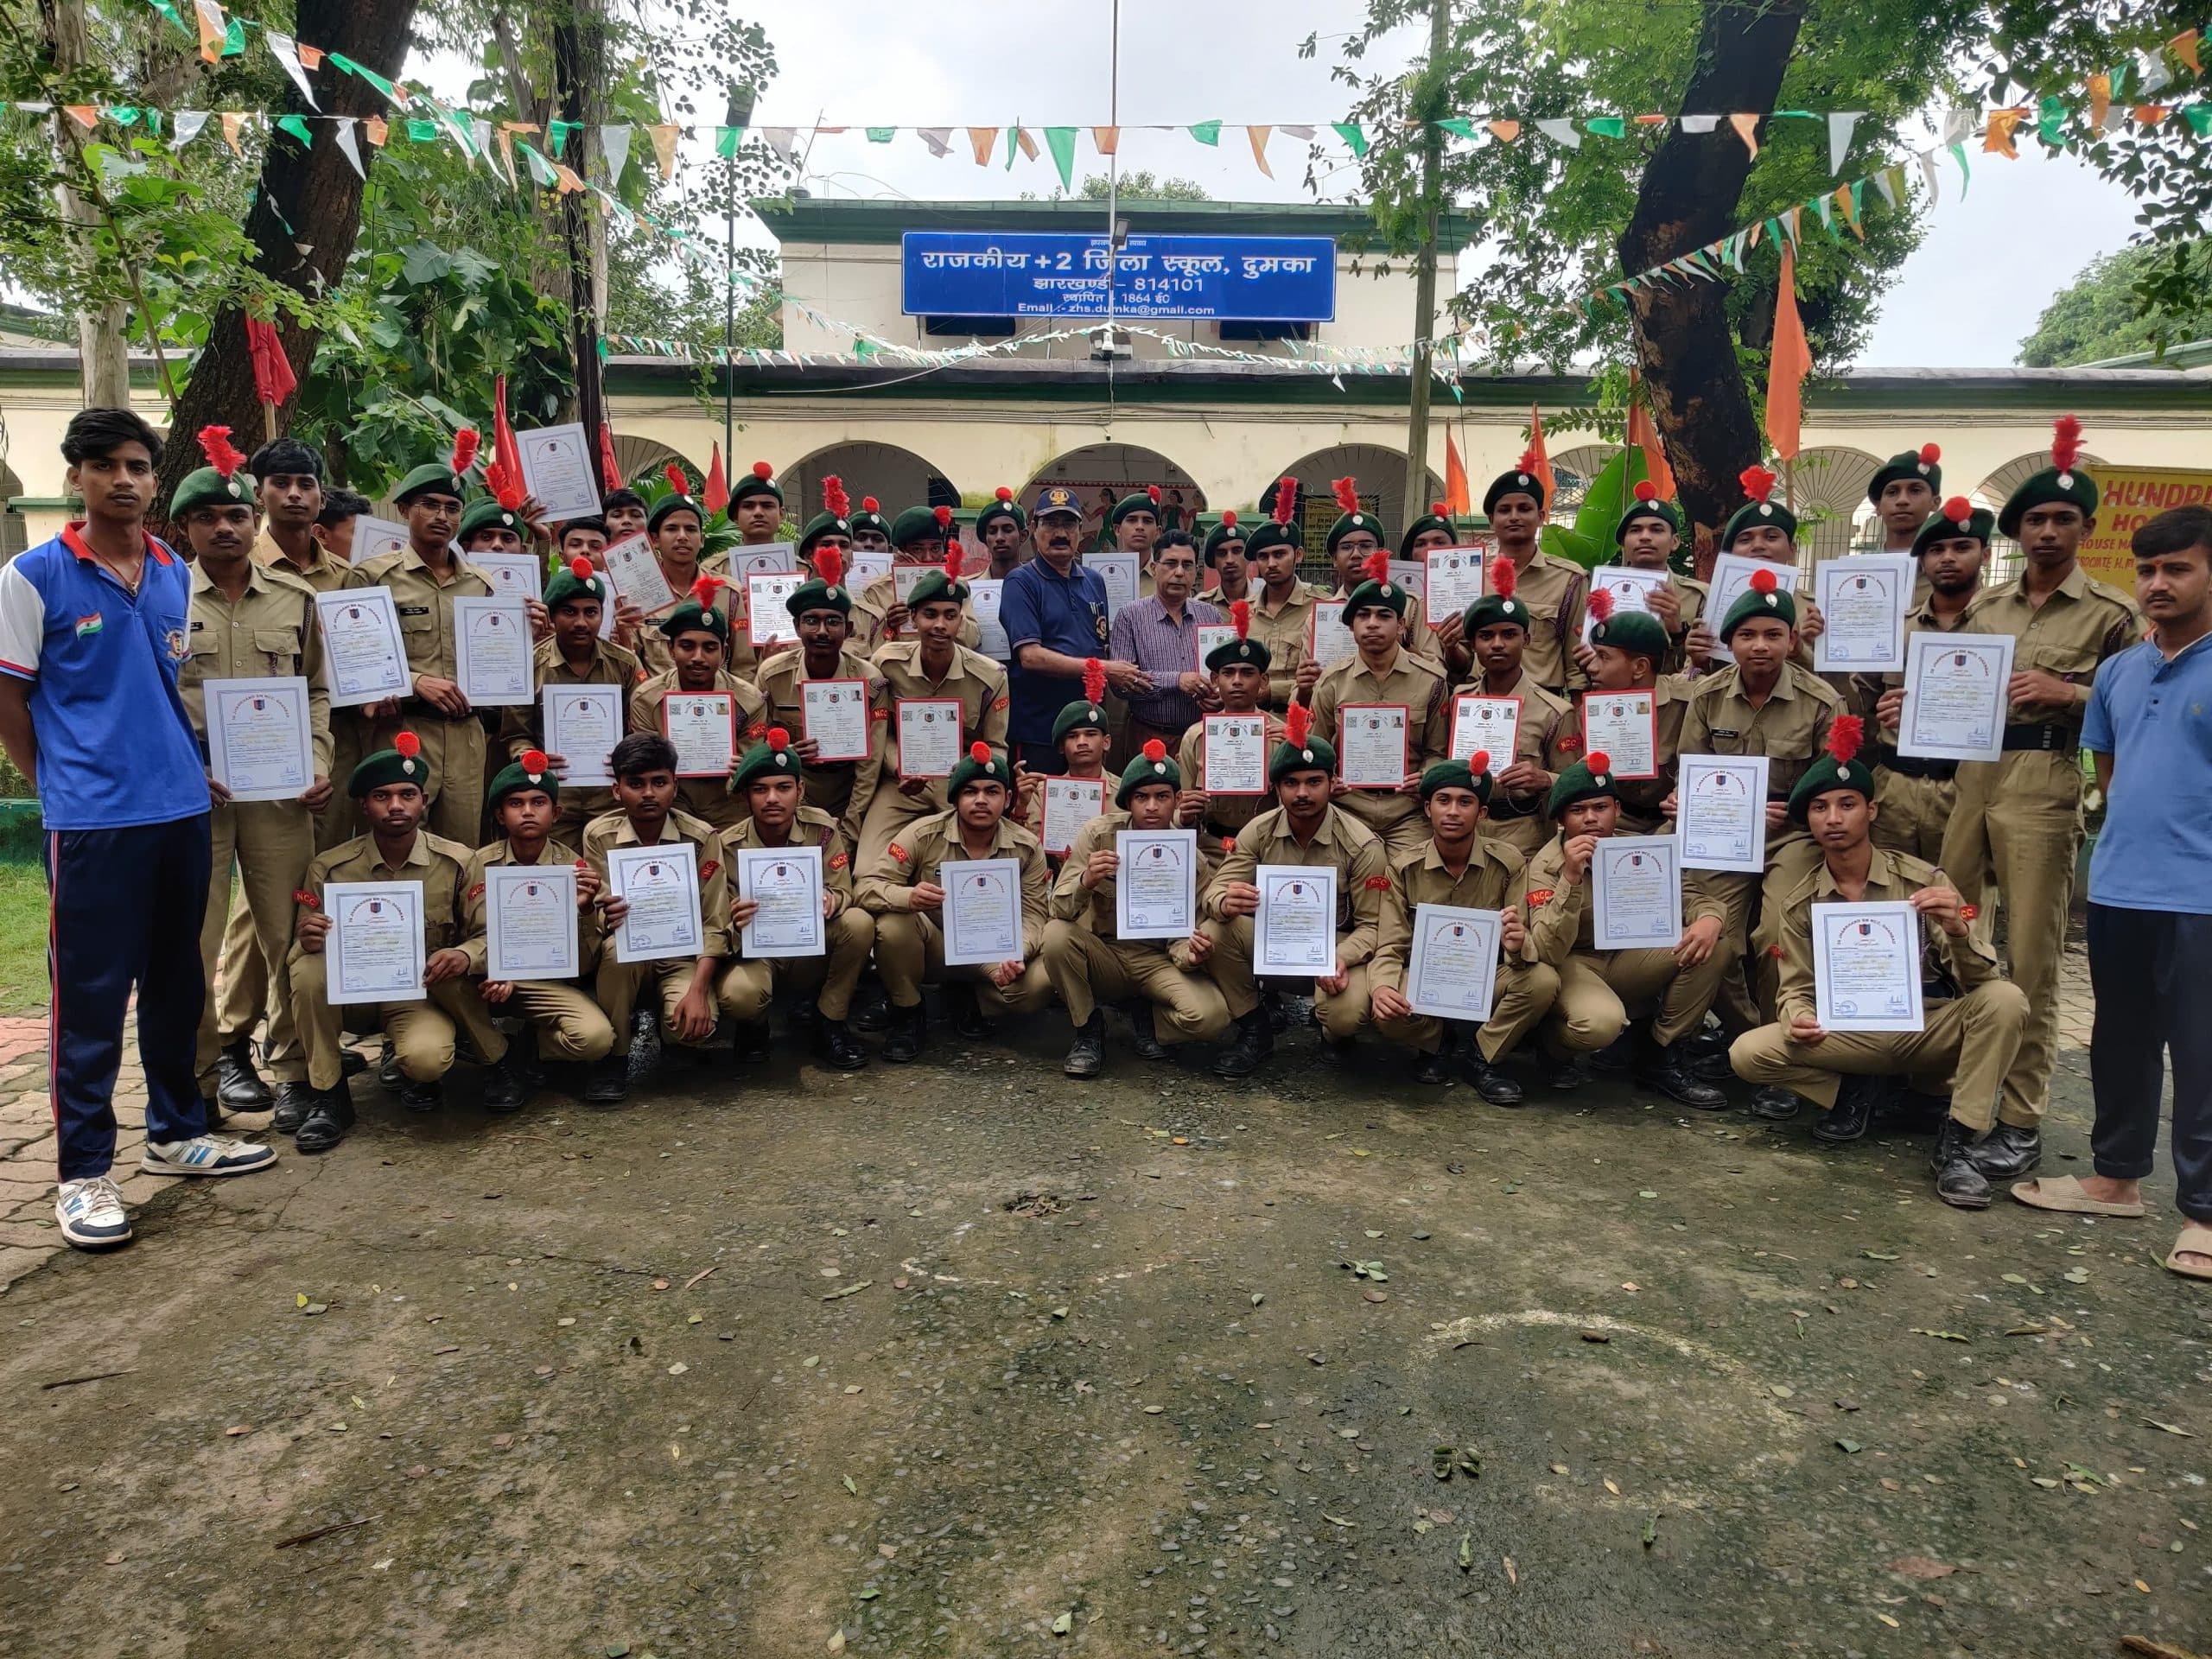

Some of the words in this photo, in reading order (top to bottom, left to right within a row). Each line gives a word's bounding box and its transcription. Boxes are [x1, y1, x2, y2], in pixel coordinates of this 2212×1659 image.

[921, 247, 1031, 270] राजकीय
[1083, 249, 1153, 271] जिला
[1161, 256, 1230, 277] स्कूल,
[1242, 257, 1317, 279] दुमका
[1135, 277, 1203, 292] 814101
[1122, 293, 1150, 303] 1864
[1018, 302, 1053, 312] Email
[1560, 739, 1576, 749] NCC
[296, 893, 316, 906] NCC
[1532, 891, 1550, 902] NCC
